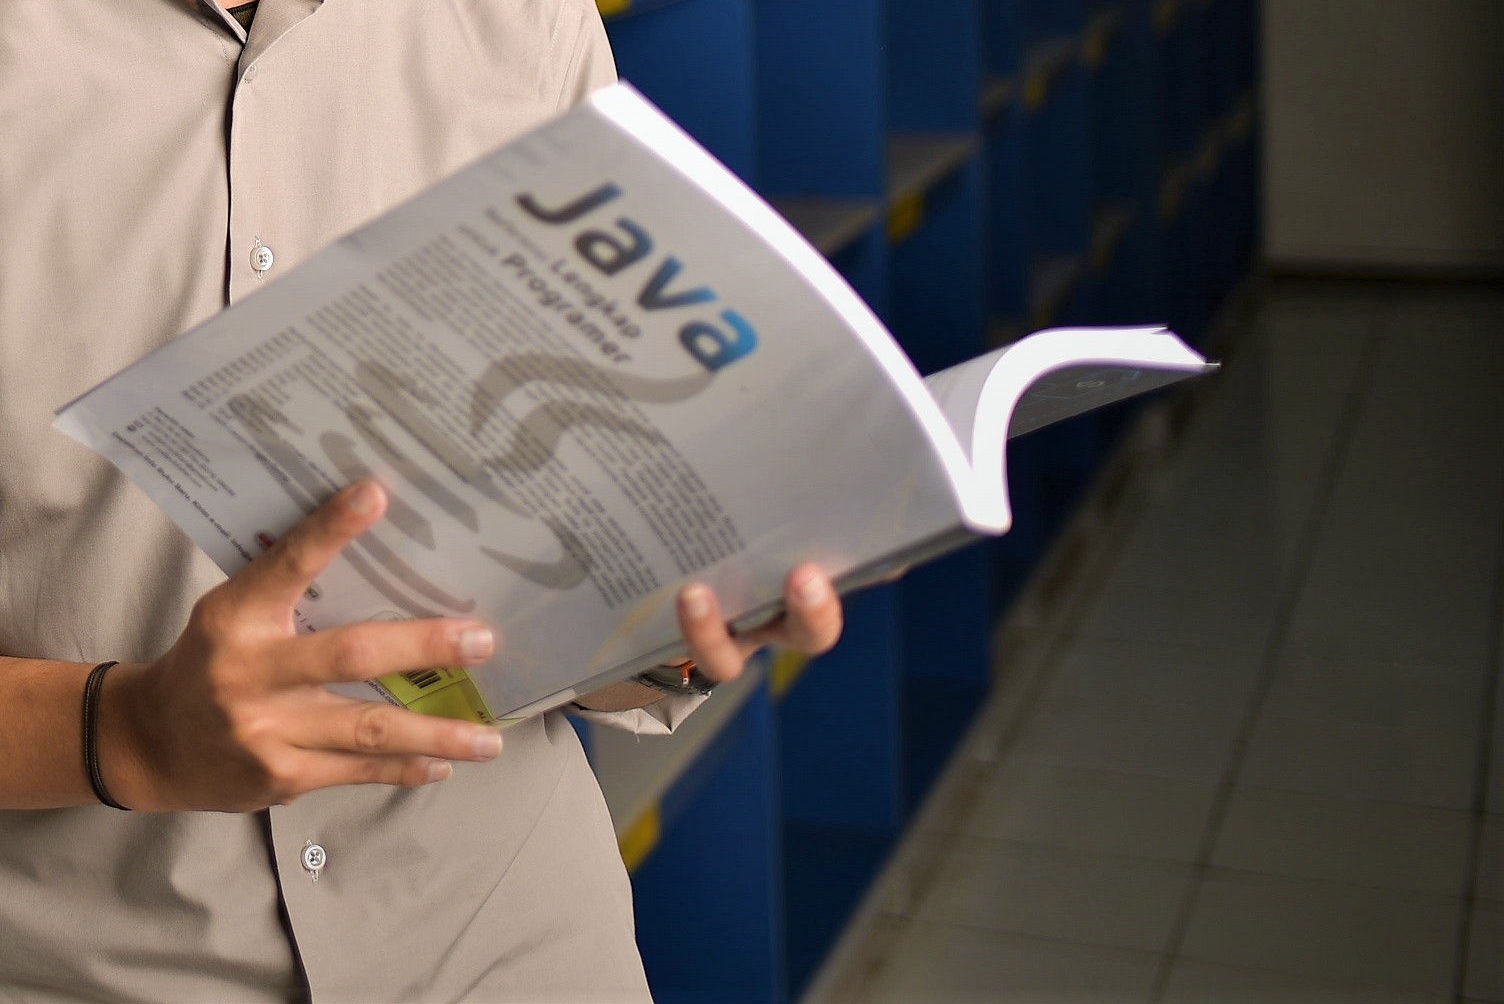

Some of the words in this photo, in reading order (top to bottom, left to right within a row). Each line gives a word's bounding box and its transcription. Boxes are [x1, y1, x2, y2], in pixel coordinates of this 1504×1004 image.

[498, 250, 636, 369] Programer
[513, 183, 761, 373] Java
[547, 256, 645, 343] Lengkap
